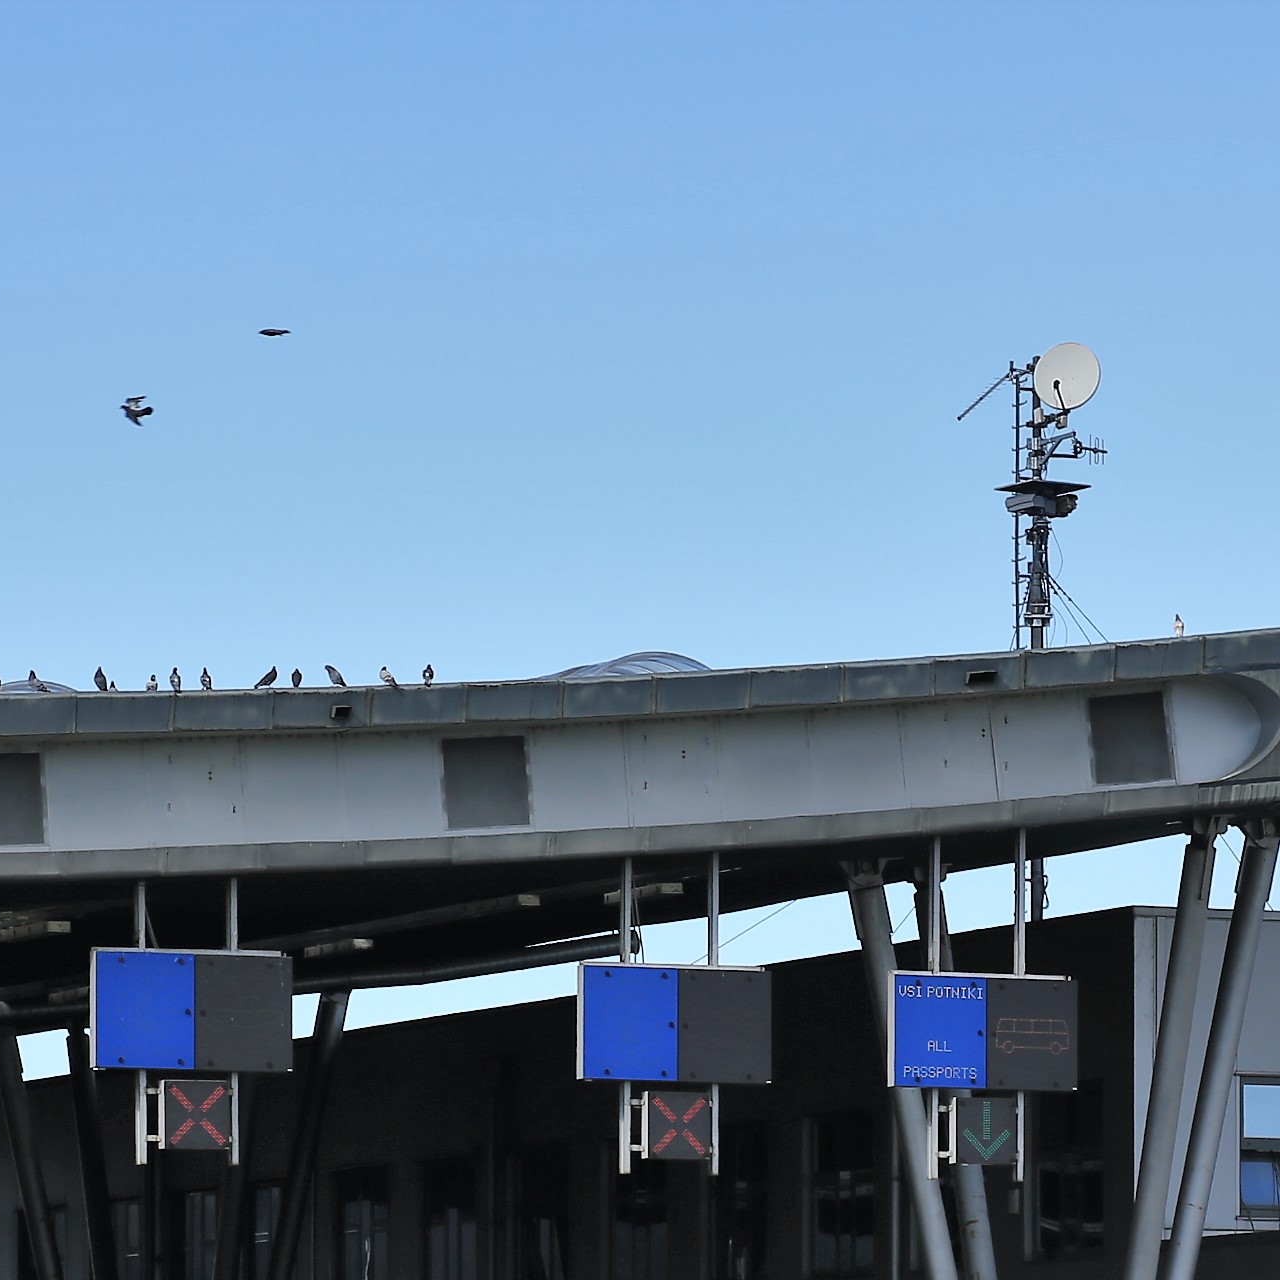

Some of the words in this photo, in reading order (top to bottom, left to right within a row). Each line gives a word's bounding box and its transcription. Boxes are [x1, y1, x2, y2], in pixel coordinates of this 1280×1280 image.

[898, 985, 922, 998] VSI
[926, 986, 983, 1000] POTNIKI
[927, 1040, 952, 1053] ALL
[903, 1065, 978, 1079] PASSPORTS
